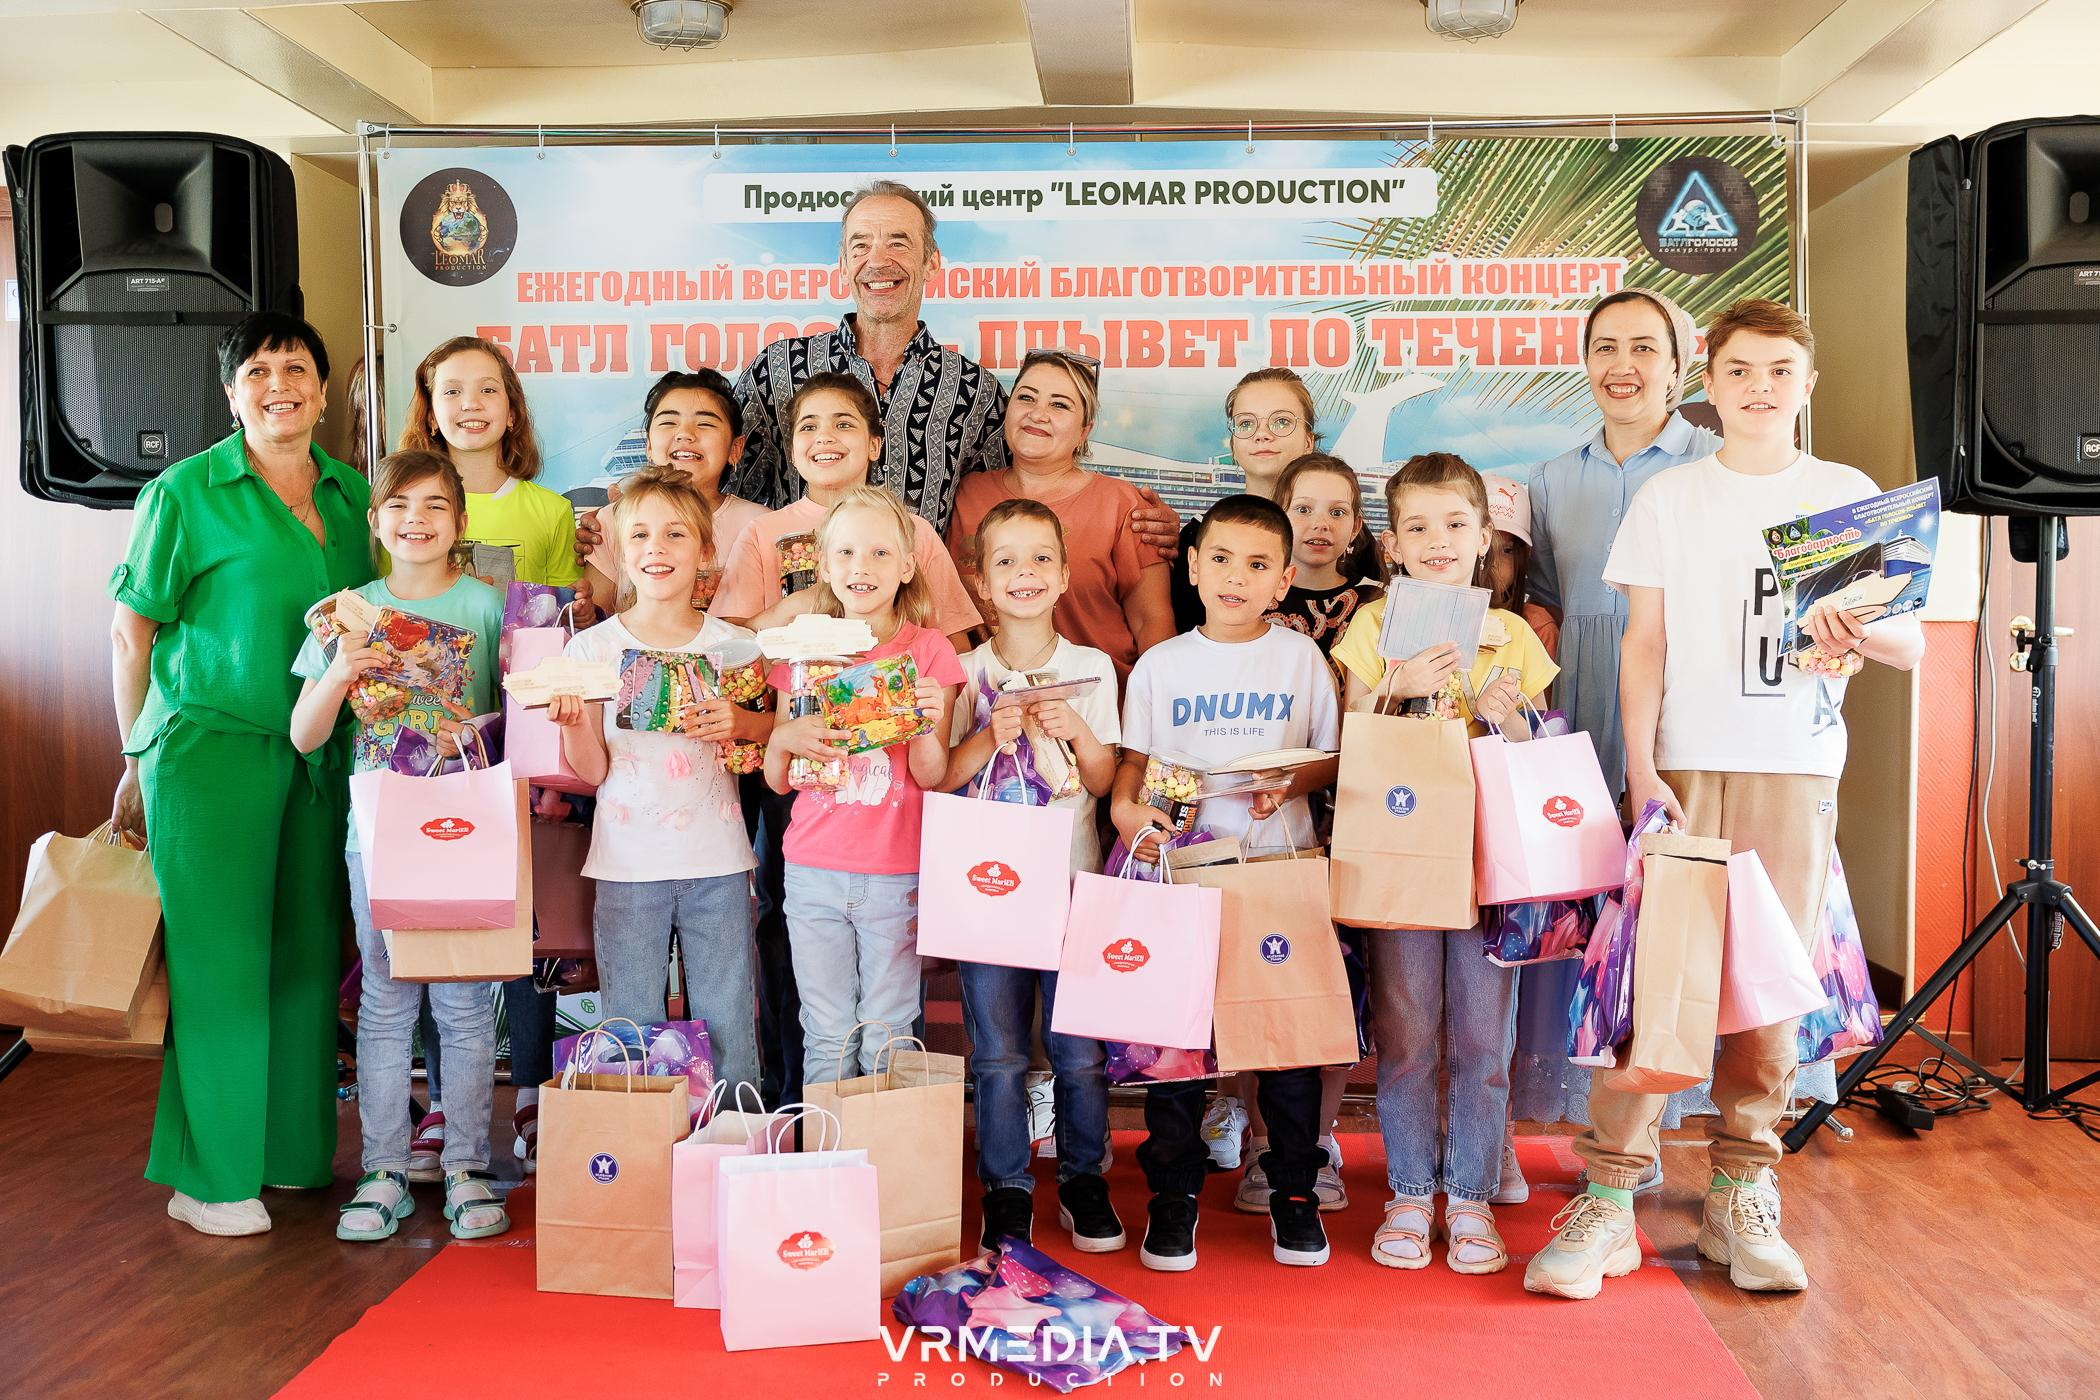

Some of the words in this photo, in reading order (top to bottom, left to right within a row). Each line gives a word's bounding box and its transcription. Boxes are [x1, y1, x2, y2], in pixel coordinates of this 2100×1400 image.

[744, 183, 954, 214] Продюсий
[962, 188, 1044, 213] центр
[1050, 181, 1186, 206] "LEOMAR
[1195, 179, 1405, 204] PRODUCTION"
[434, 248, 486, 265] LEOMAR
[435, 264, 487, 272] PRODUCTION
[517, 263, 733, 306] ЕЖЕГОДНЫЙ
[1051, 260, 1451, 297] БЛАГОТВОРИТЕЛЬНЫЙ
[1461, 262, 1622, 298] КОНЦЕРТ
[1269, 317, 1350, 367] ПО
[145, 440, 160, 448] RCF
[1773, 527, 1861, 561] Благодарность
[1172, 692, 1295, 727] DNUMX
[1204, 728, 1227, 737] THIS
[1229, 727, 1240, 736] IS
[1243, 728, 1265, 737] LIFE
[1546, 811, 1563, 819] Sweet
[972, 873, 991, 884] Sweet
[1106, 952, 1124, 961] Sweet
[782, 1249, 803, 1258] Sweet
